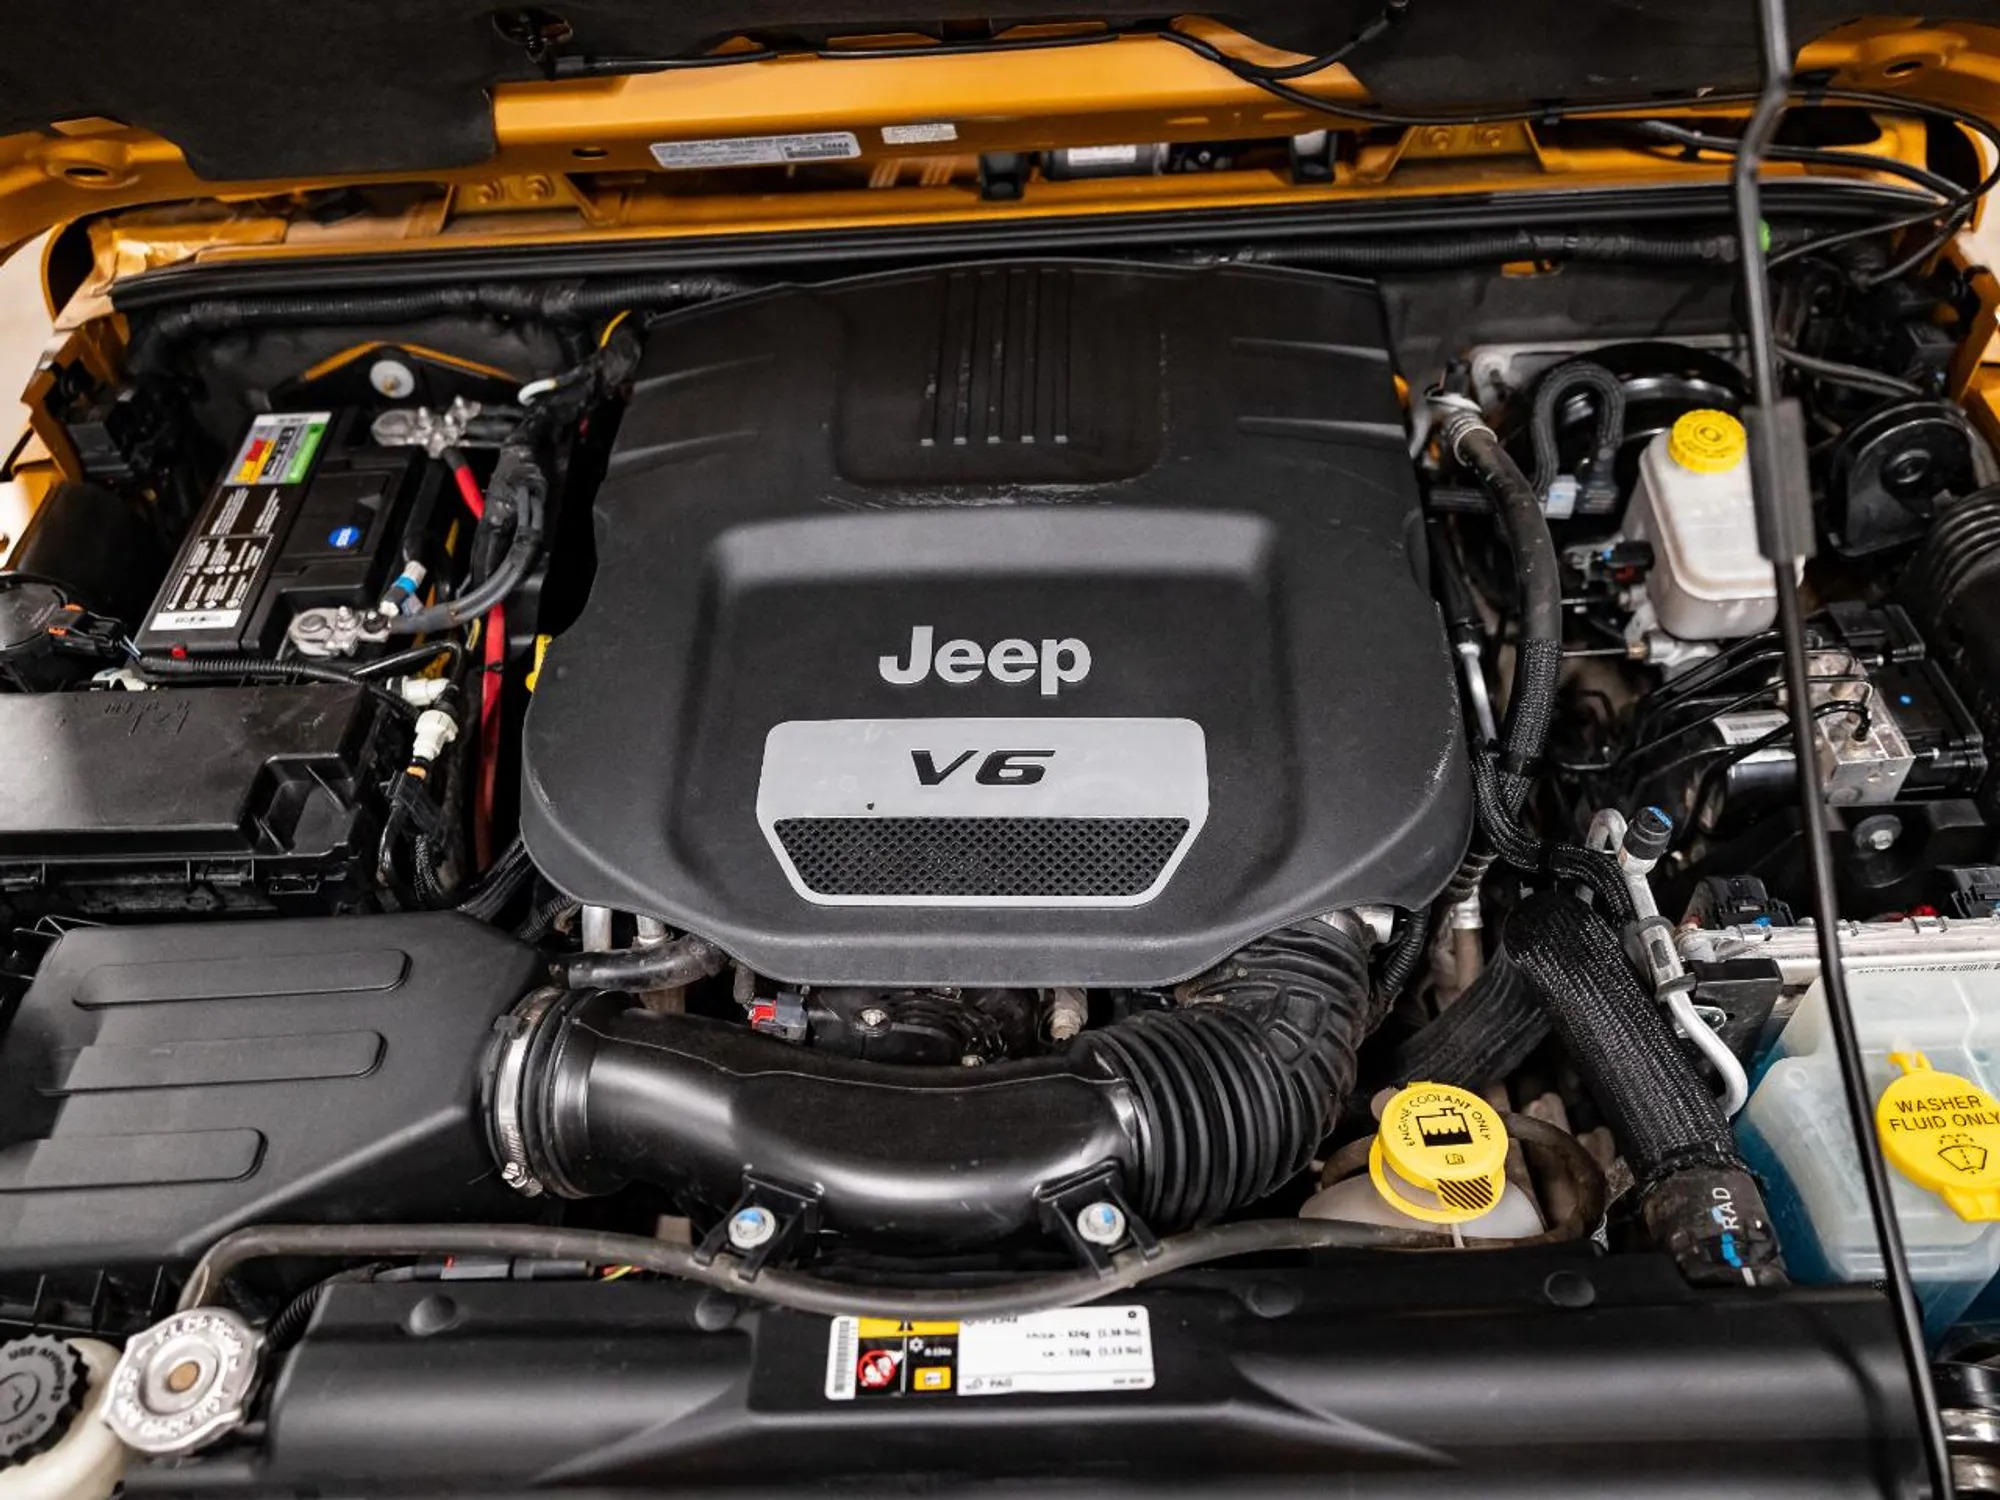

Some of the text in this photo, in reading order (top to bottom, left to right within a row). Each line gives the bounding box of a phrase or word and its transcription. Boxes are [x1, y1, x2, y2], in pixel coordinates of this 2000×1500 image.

[878, 625, 1092, 695] Jeep
[911, 750, 1056, 785] V6
[1398, 1094, 1490, 1146] ENGINE COOLANT ONLY
[1889, 1111, 2000, 1131] FLUID ONLY
[1895, 1095, 1981, 1113] WASHER
[1712, 1187, 1740, 1229] RAD
